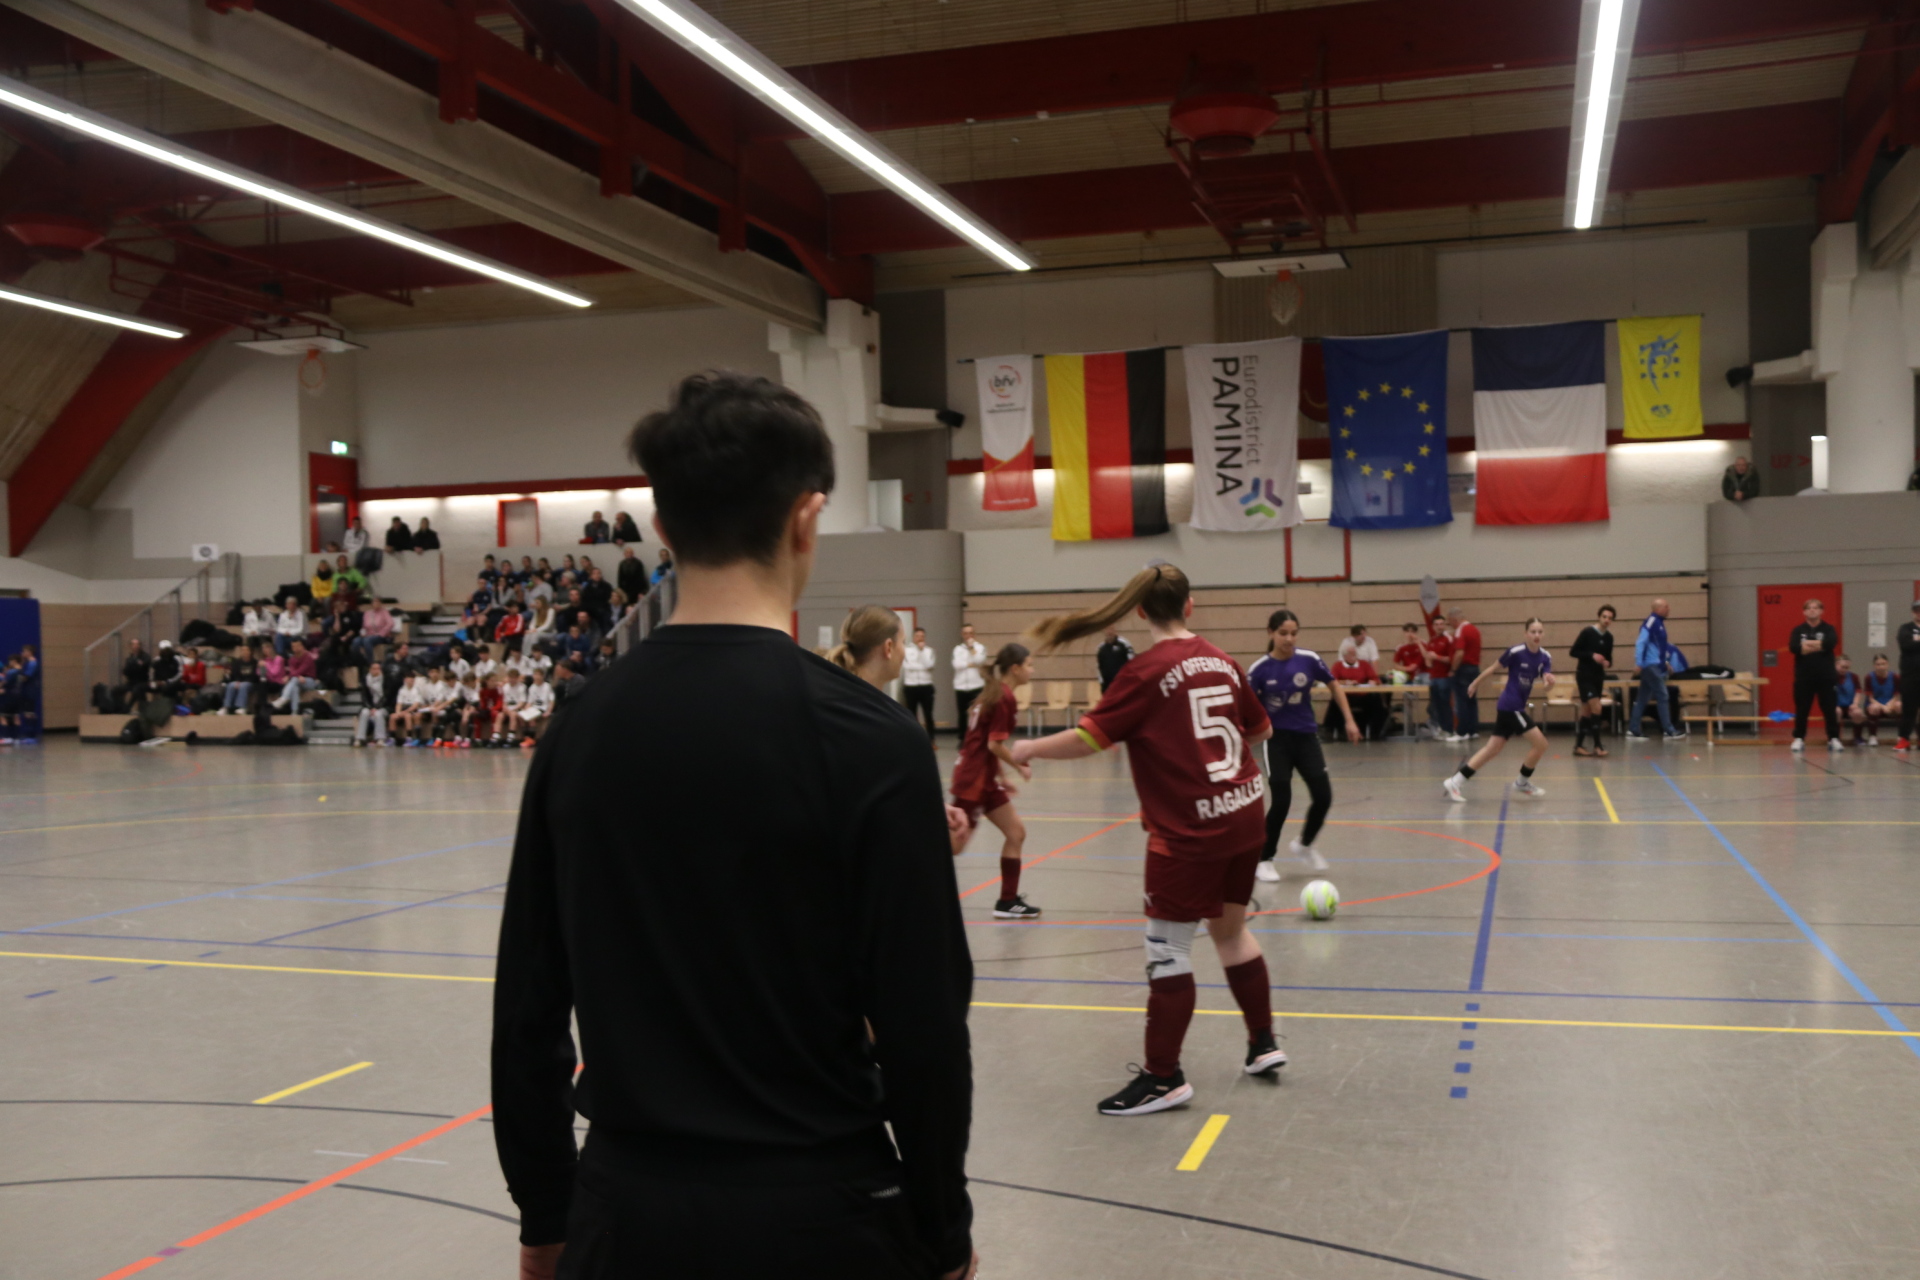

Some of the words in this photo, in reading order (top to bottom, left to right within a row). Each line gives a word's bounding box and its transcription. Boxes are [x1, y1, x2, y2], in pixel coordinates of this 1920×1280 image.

[1212, 357, 1243, 496] PAMINA
[1243, 355, 1262, 466] Eurodistrict
[1159, 665, 1185, 697] FSV
[1188, 684, 1243, 783] 5
